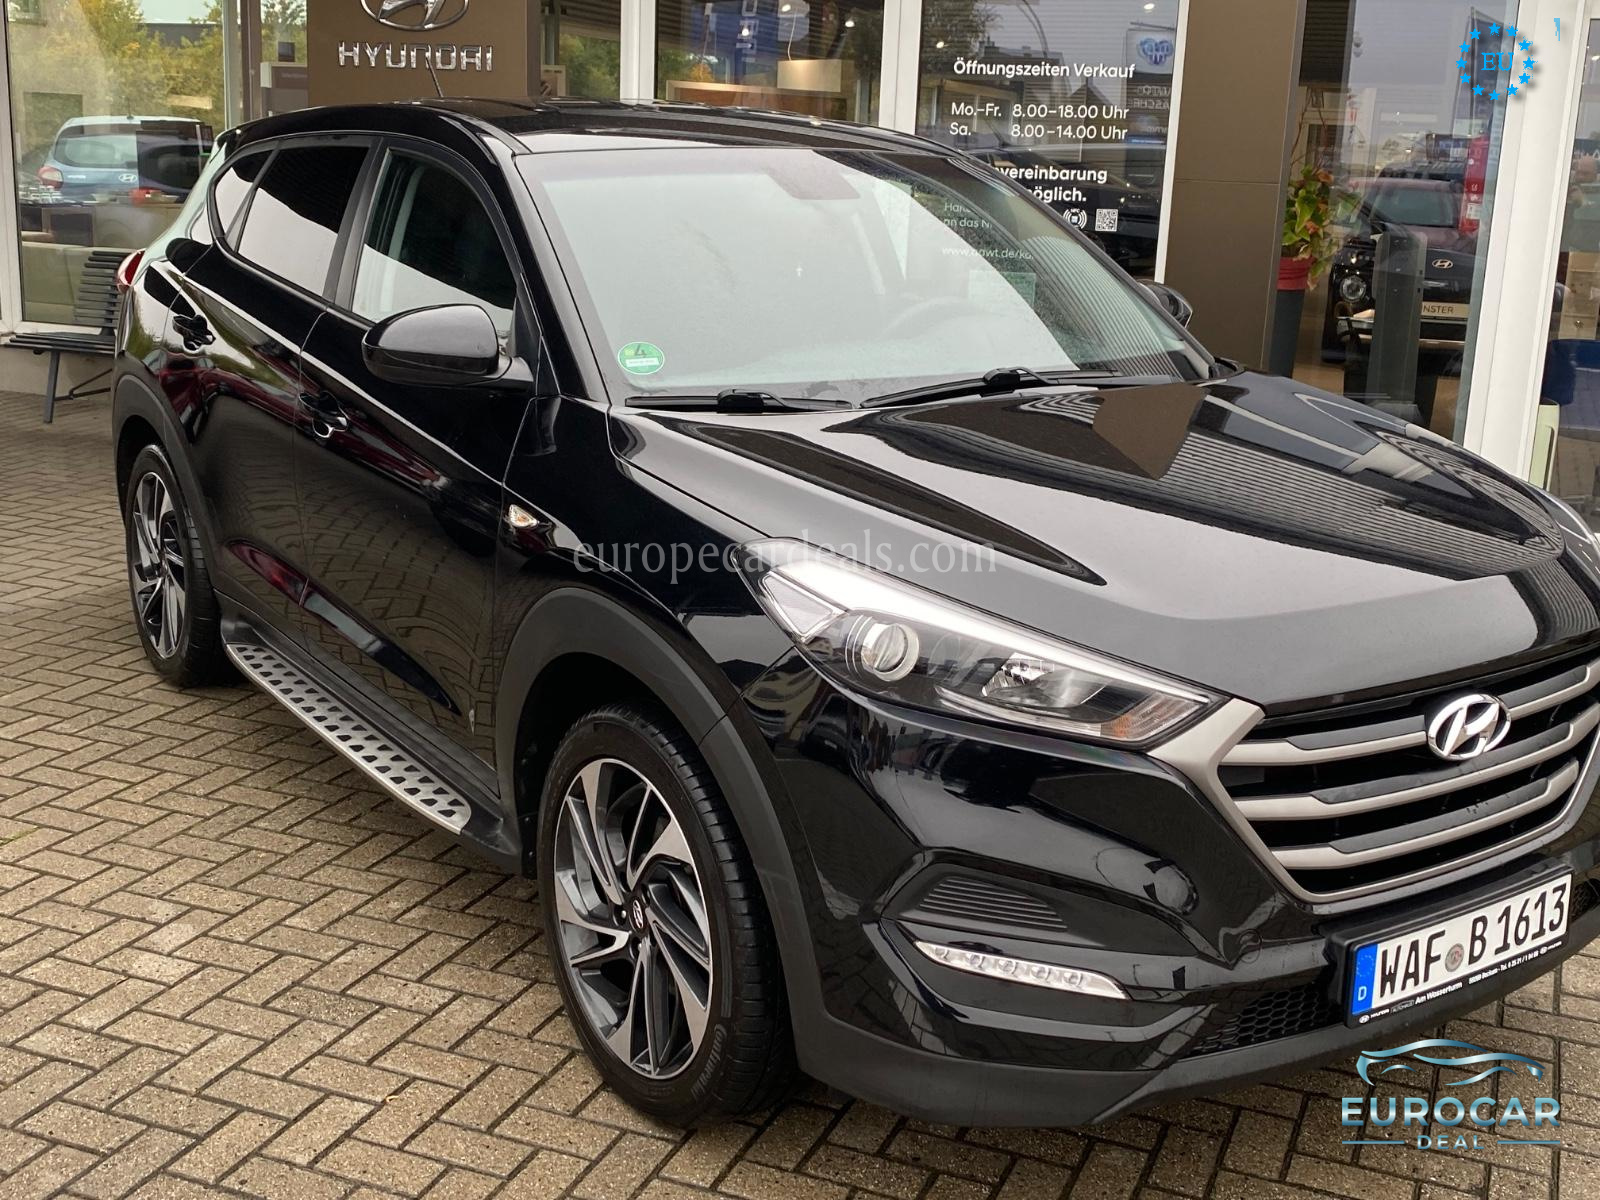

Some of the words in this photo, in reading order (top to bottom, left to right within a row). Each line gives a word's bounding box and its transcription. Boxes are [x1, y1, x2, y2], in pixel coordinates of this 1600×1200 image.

[337, 40, 493, 72] HYUNDAI
[952, 57, 1070, 79] Öffnungszeiten
[1073, 63, 1136, 79] Verkauf
[1102, 106, 1129, 120] Uhr
[949, 122, 972, 137] Sa.
[1101, 126, 1128, 140] Uhr
[1028, 187, 1087, 203] öglich.
[959, 217, 979, 228] das
[1379, 929, 1446, 998] WAF
[1467, 914, 1488, 965] B
[1494, 882, 1567, 955] 1613
[1357, 985, 1367, 1001] D
